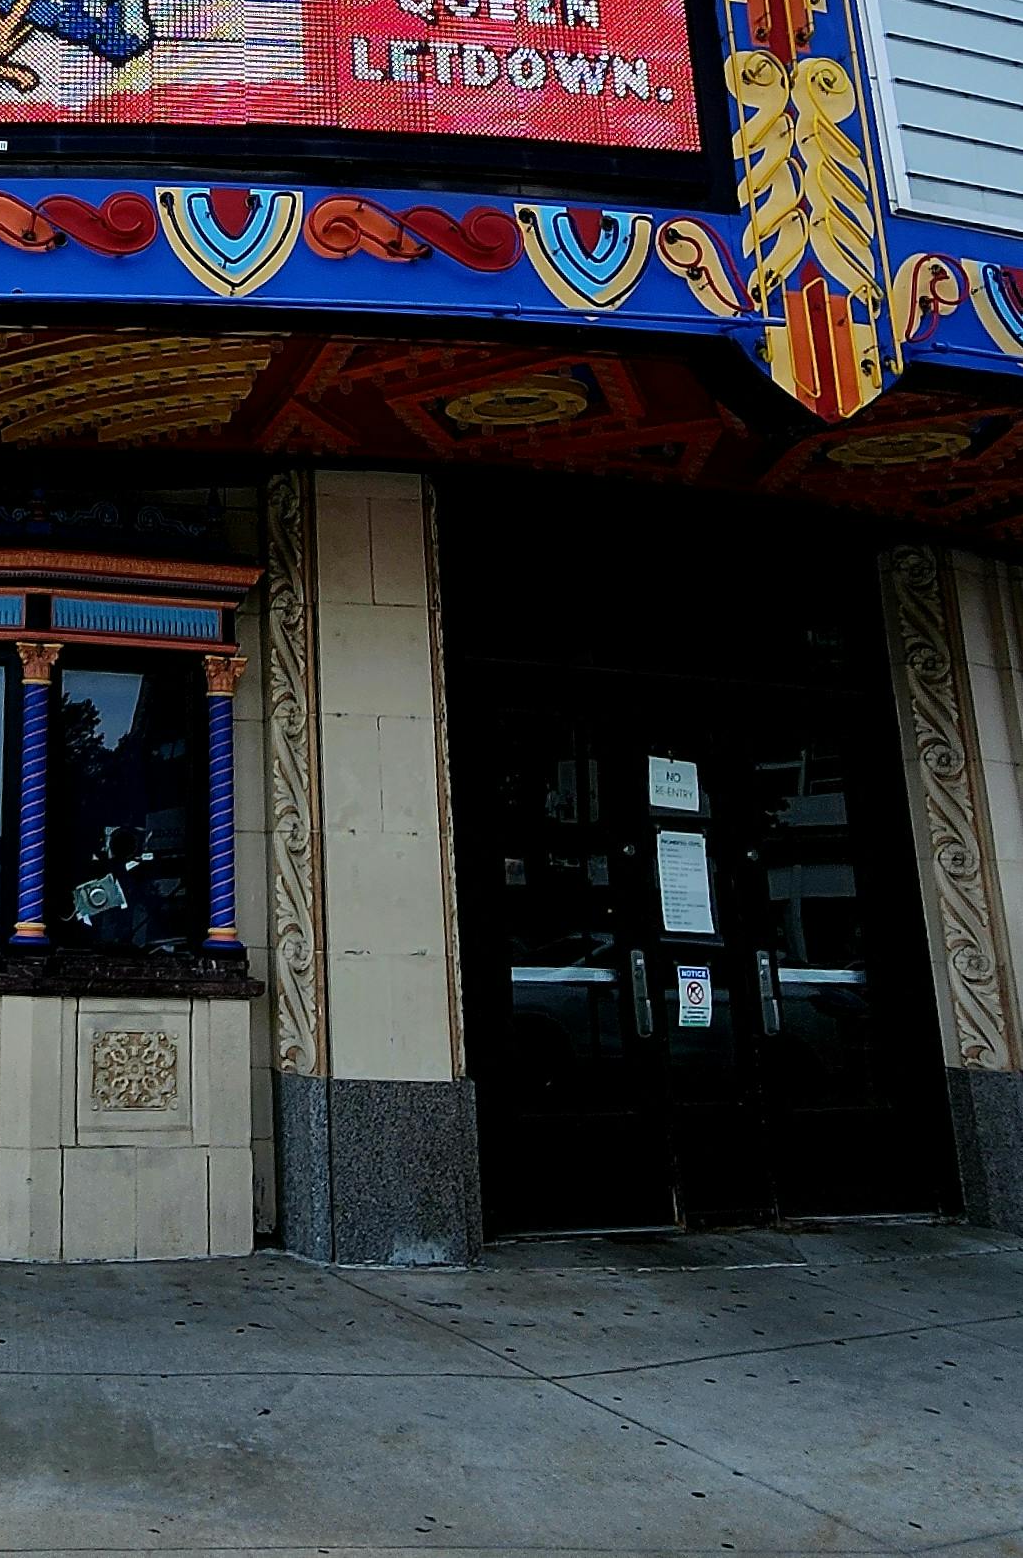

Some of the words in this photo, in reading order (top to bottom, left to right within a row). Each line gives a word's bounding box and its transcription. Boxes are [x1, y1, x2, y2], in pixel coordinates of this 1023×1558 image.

[351, 35, 675, 102] LETDOWN.
[666, 771, 682, 783] NO
[681, 969, 707, 979] NOTICE
